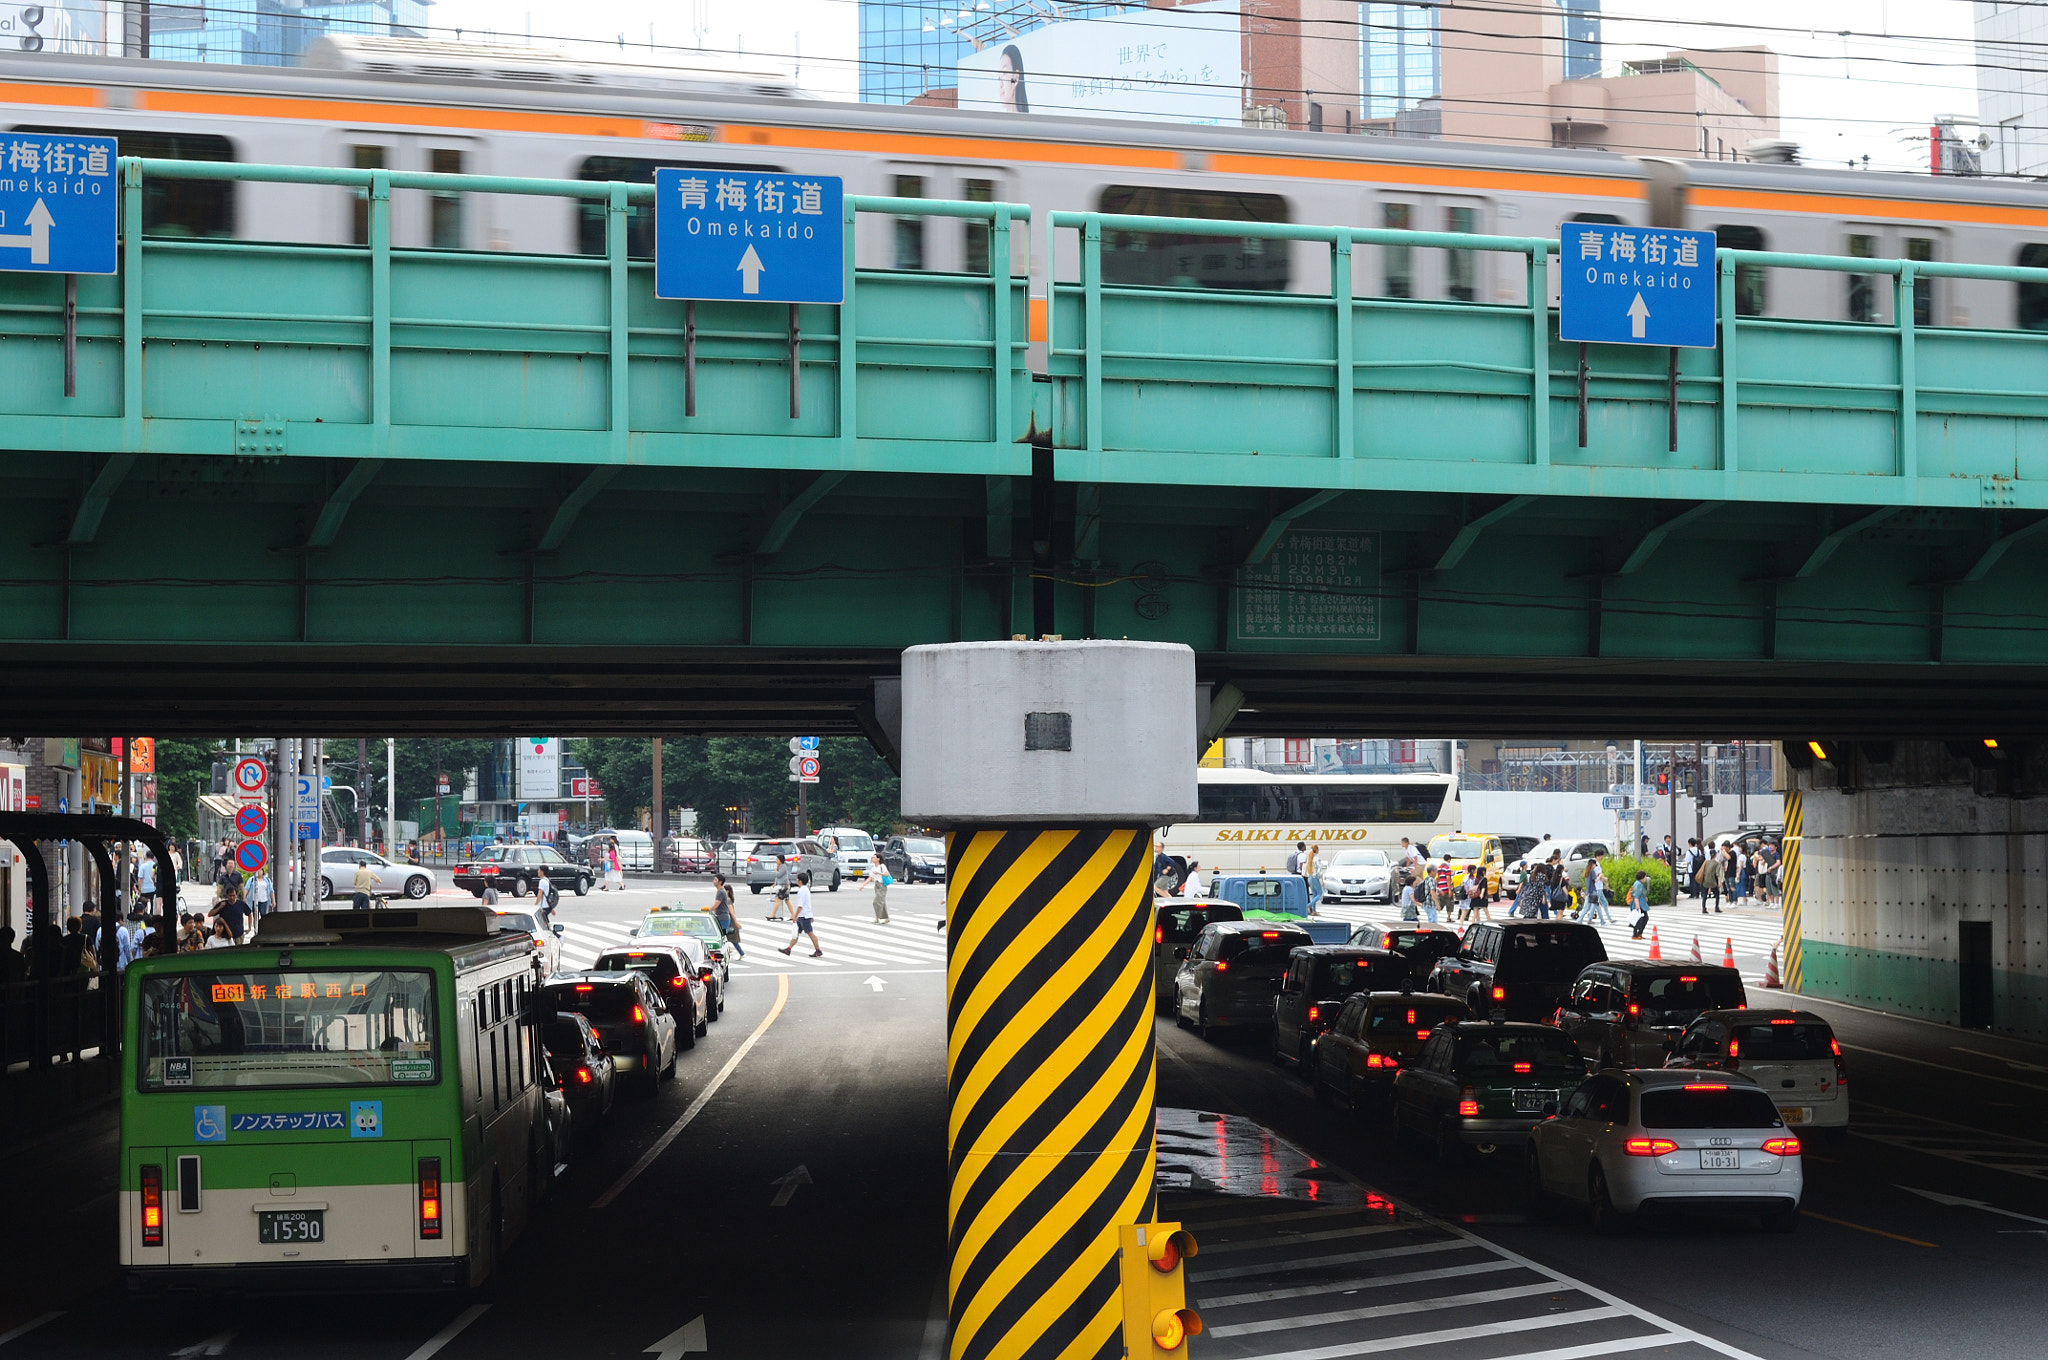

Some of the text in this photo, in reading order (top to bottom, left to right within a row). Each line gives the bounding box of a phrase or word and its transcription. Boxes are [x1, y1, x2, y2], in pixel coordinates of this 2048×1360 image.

[1117, 42, 1168, 65] 世界で
[0, 140, 110, 177] 梅街道
[0, 176, 101, 195] mekaido
[678, 176, 823, 216] 青梅街道
[687, 216, 814, 240] Omekaido
[1578, 230, 1699, 268] 青梅街道
[1586, 266, 1691, 290] Omekaido
[1215, 829, 1368, 842] SAIKI KANKO
[250, 983, 367, 1000] 新宿駅西口
[169, 1062, 187, 1072] NBA
[233, 1112, 345, 1130] ノンステップバス
[1710, 1156, 1736, 1168] 10-31
[273, 1220, 320, 1241] 15-90
